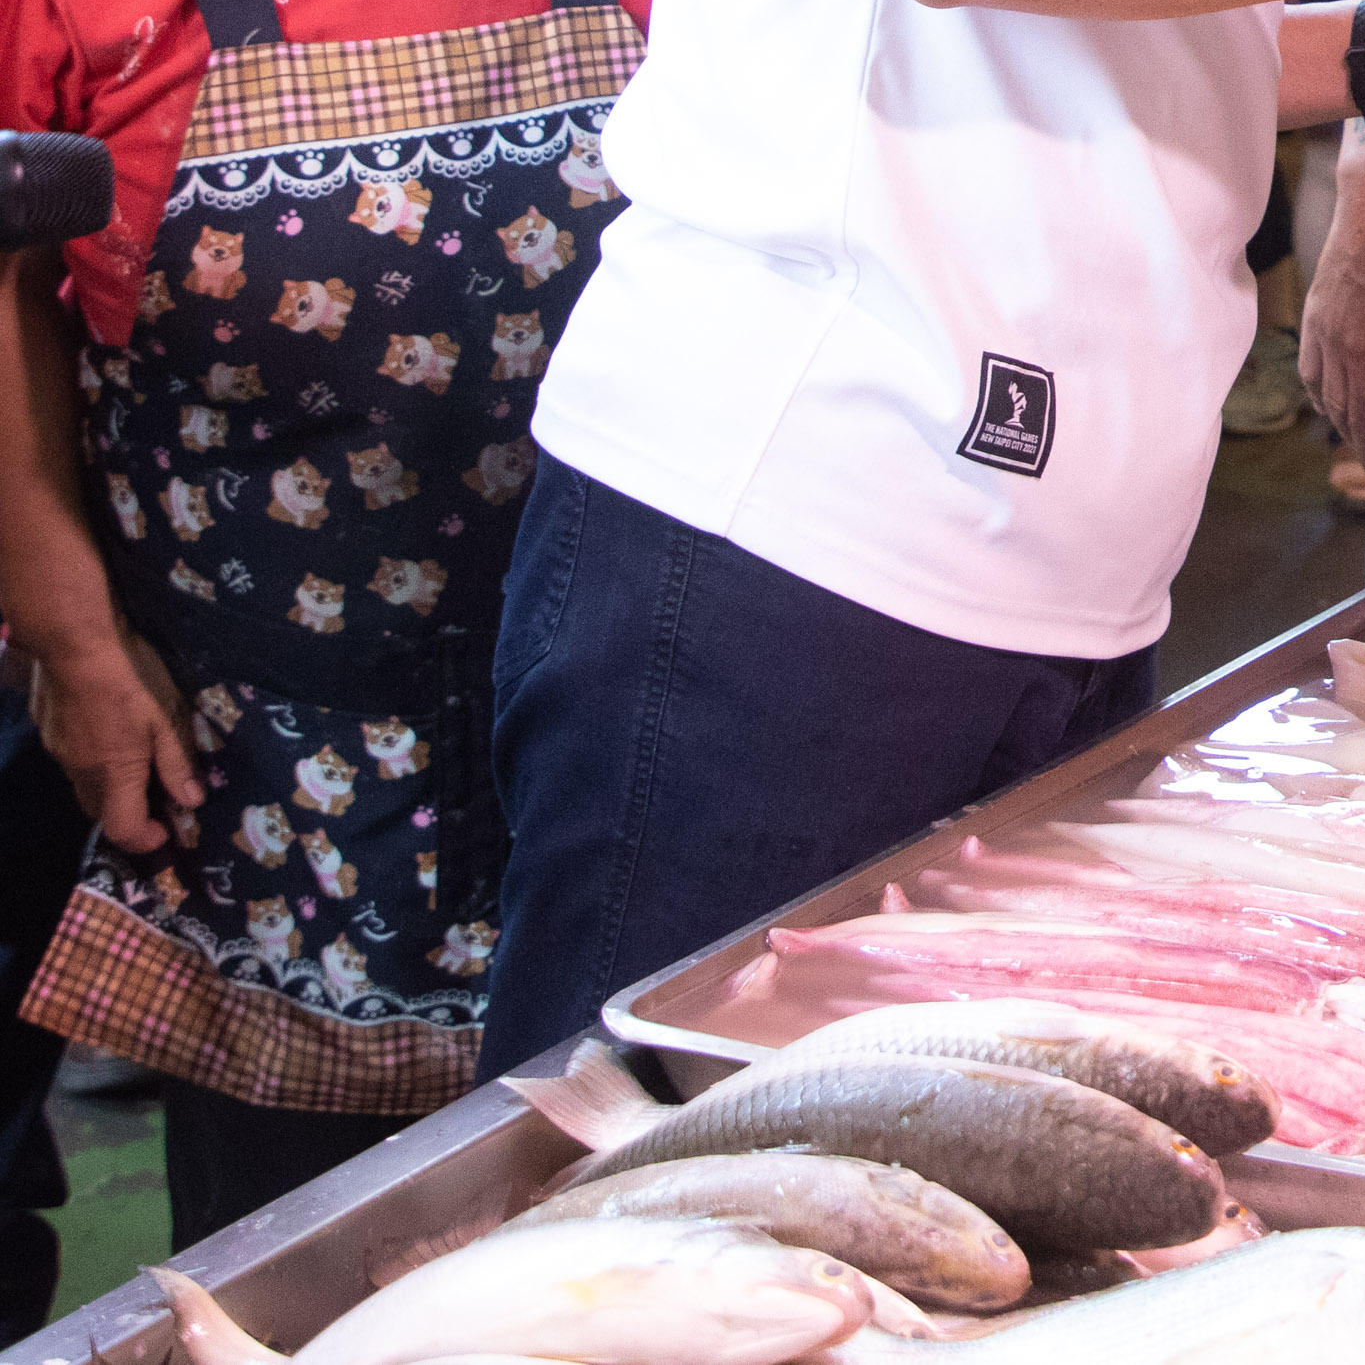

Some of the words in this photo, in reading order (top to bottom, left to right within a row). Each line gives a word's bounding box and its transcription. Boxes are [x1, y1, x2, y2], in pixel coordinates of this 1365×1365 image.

[980, 432, 995, 443] NEW
[994, 436, 1012, 447] TAIPEI
[1011, 440, 1024, 451] CITY
[1022, 443, 1037, 453] 2021
[985, 422, 996, 433] THE
[995, 425, 1020, 439] NATIONAL
[1021, 432, 1039, 443] GAMES
